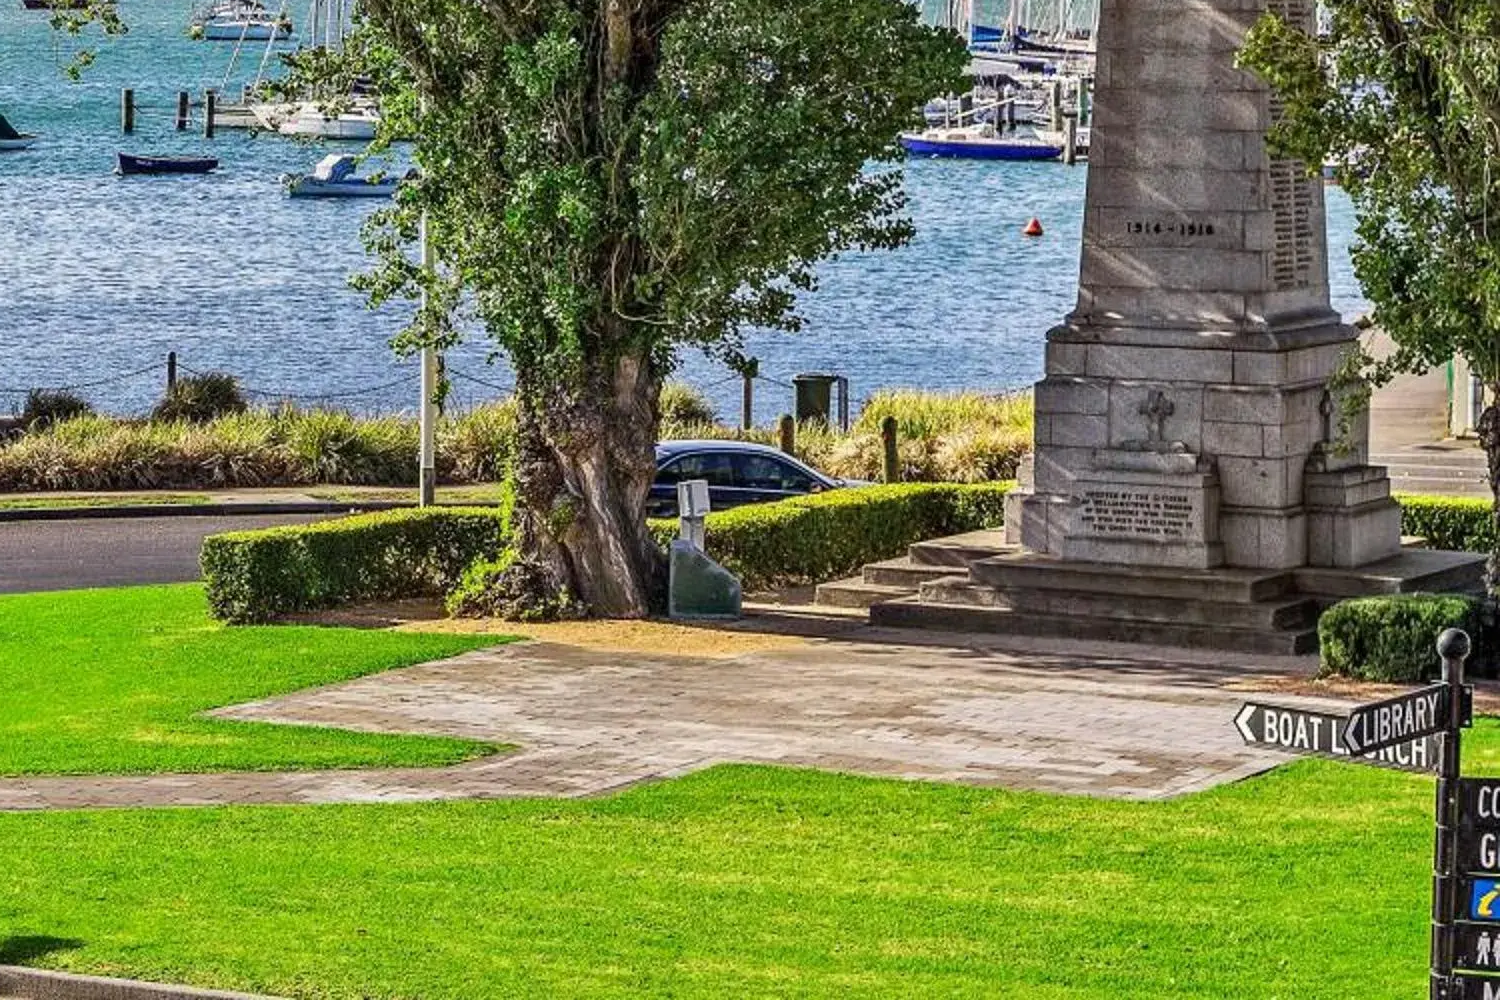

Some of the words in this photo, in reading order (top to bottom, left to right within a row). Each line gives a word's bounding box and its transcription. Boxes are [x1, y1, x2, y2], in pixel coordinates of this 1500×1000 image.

[1264, 710, 1322, 750] BOAT
[1332, 719, 1427, 767] LCH
[1363, 692, 1439, 746] LIBRARY
[1481, 833, 1500, 869] G
